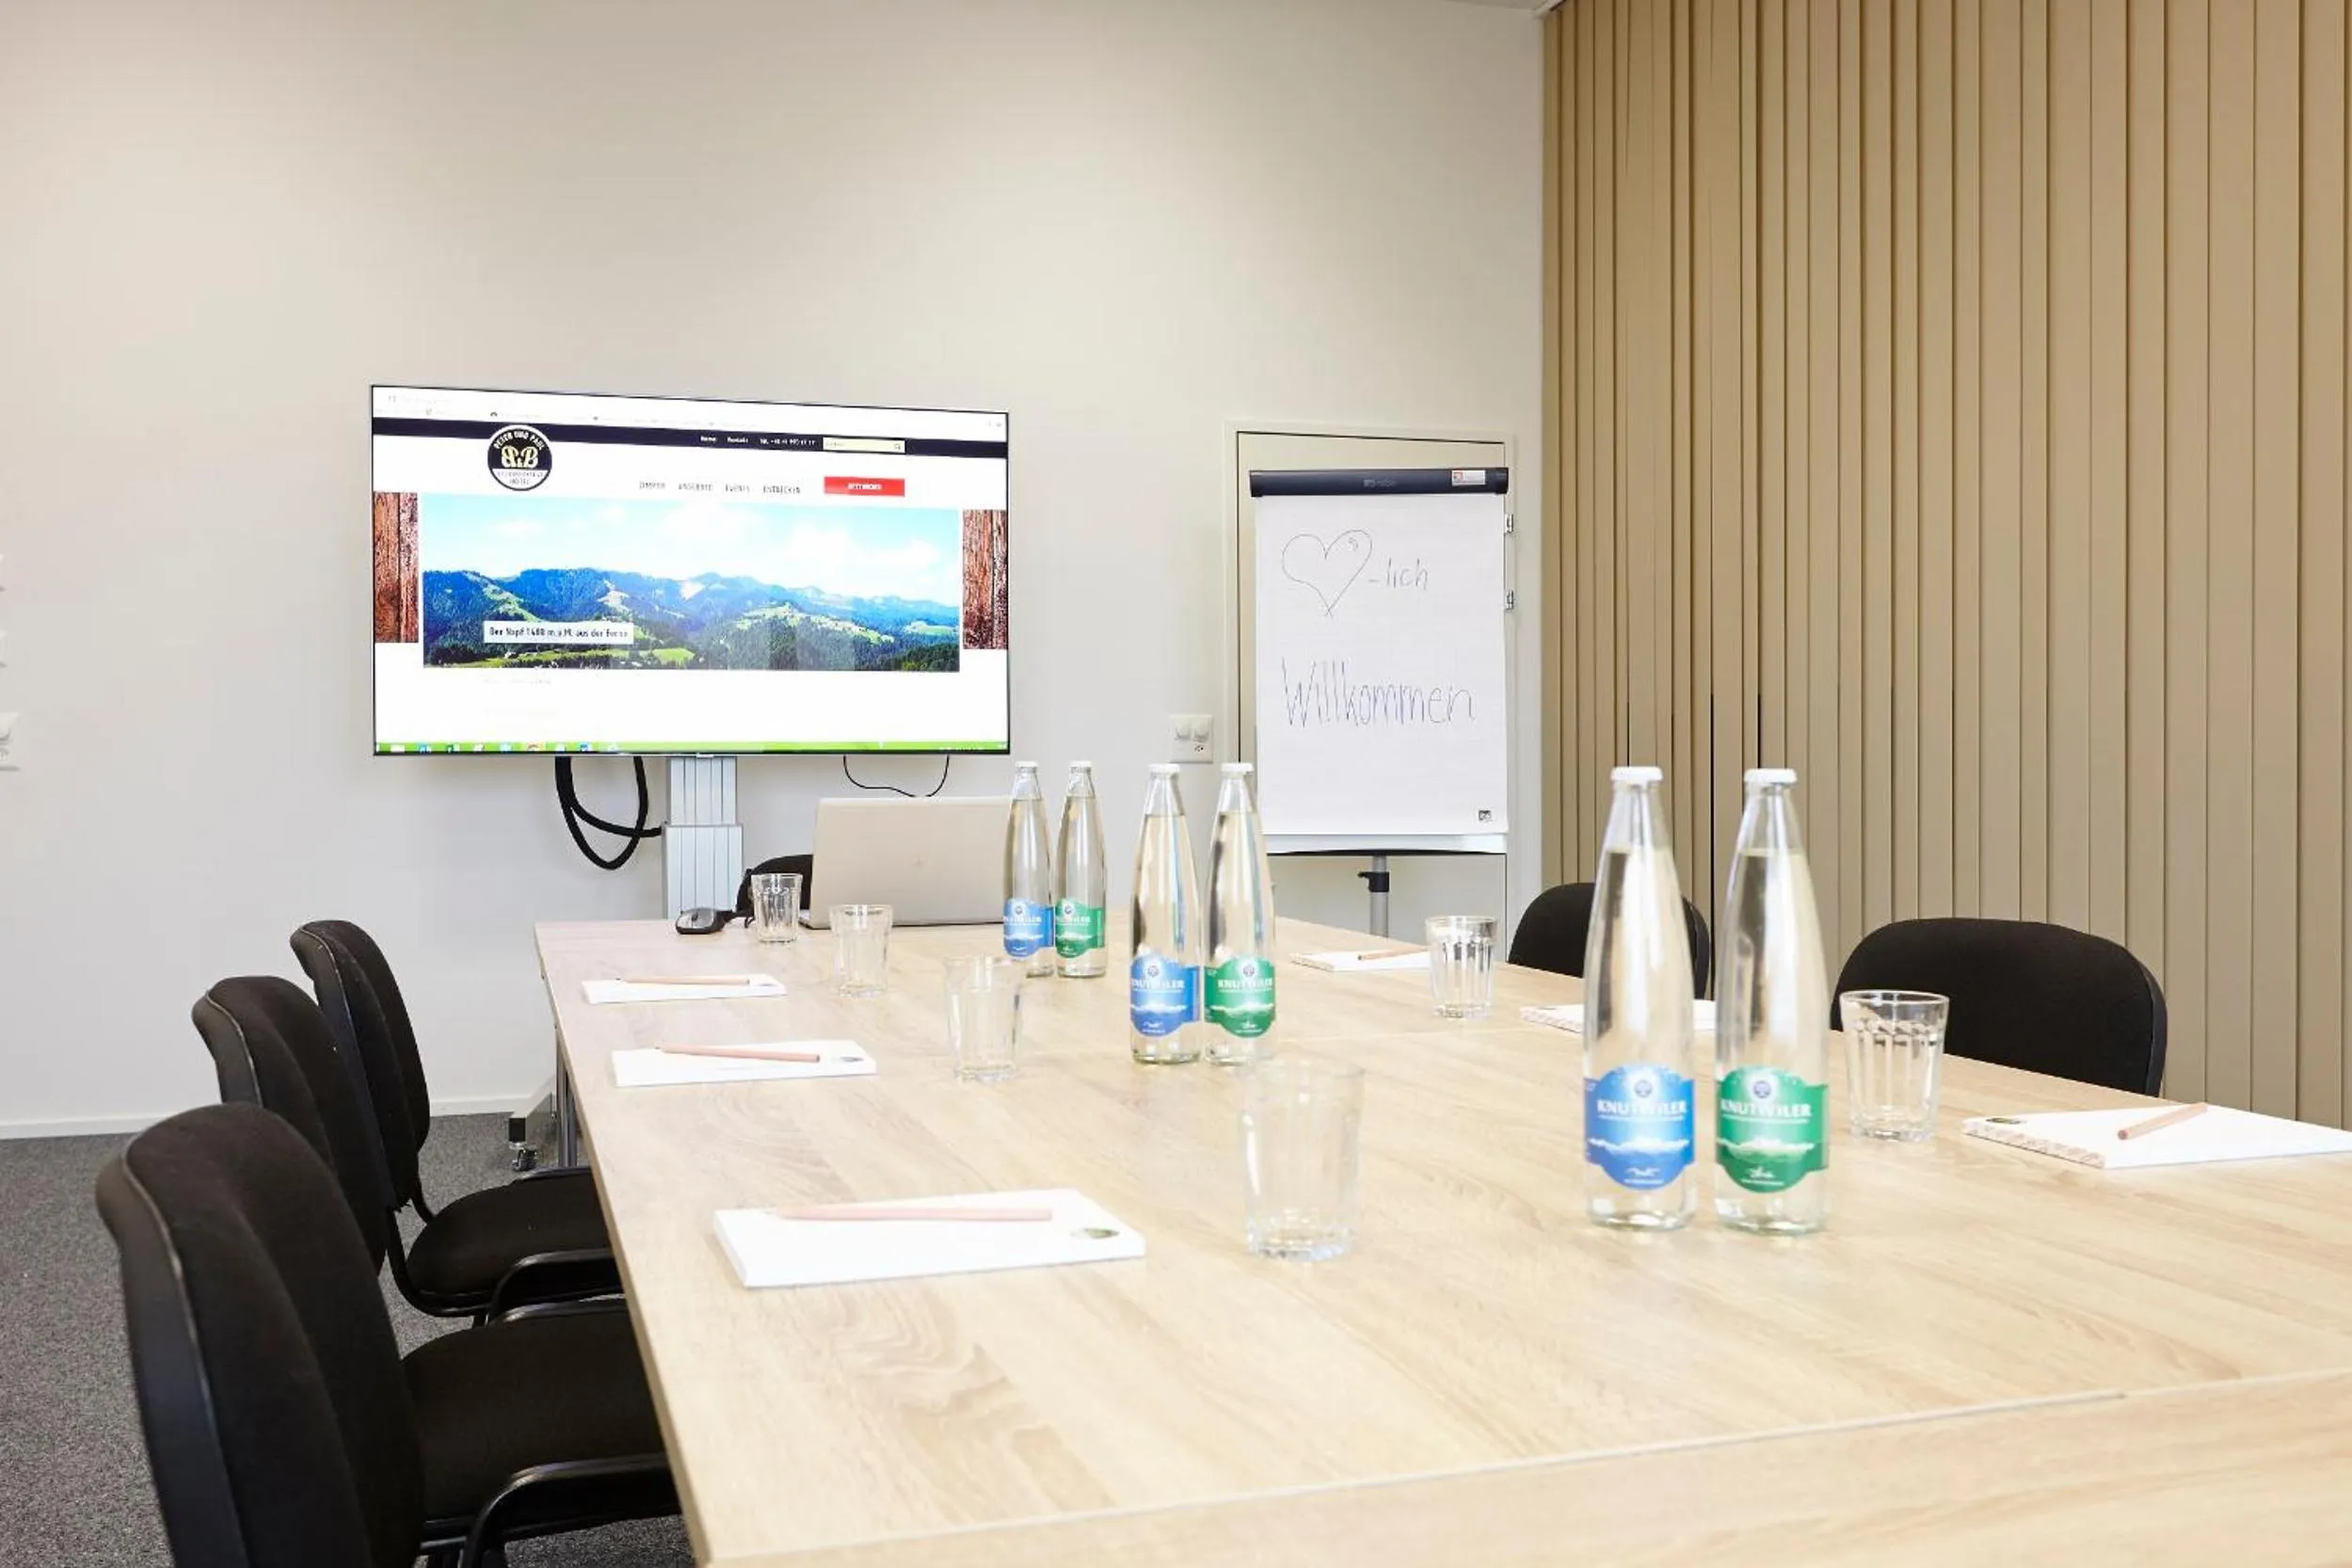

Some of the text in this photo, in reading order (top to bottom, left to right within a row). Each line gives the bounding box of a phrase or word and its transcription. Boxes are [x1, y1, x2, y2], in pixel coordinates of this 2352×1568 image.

[1281, 656, 1477, 728] Willkommen
[1596, 1098, 1688, 1115] KNUTWILER
[1720, 1098, 1813, 1117] KNUTWILER
